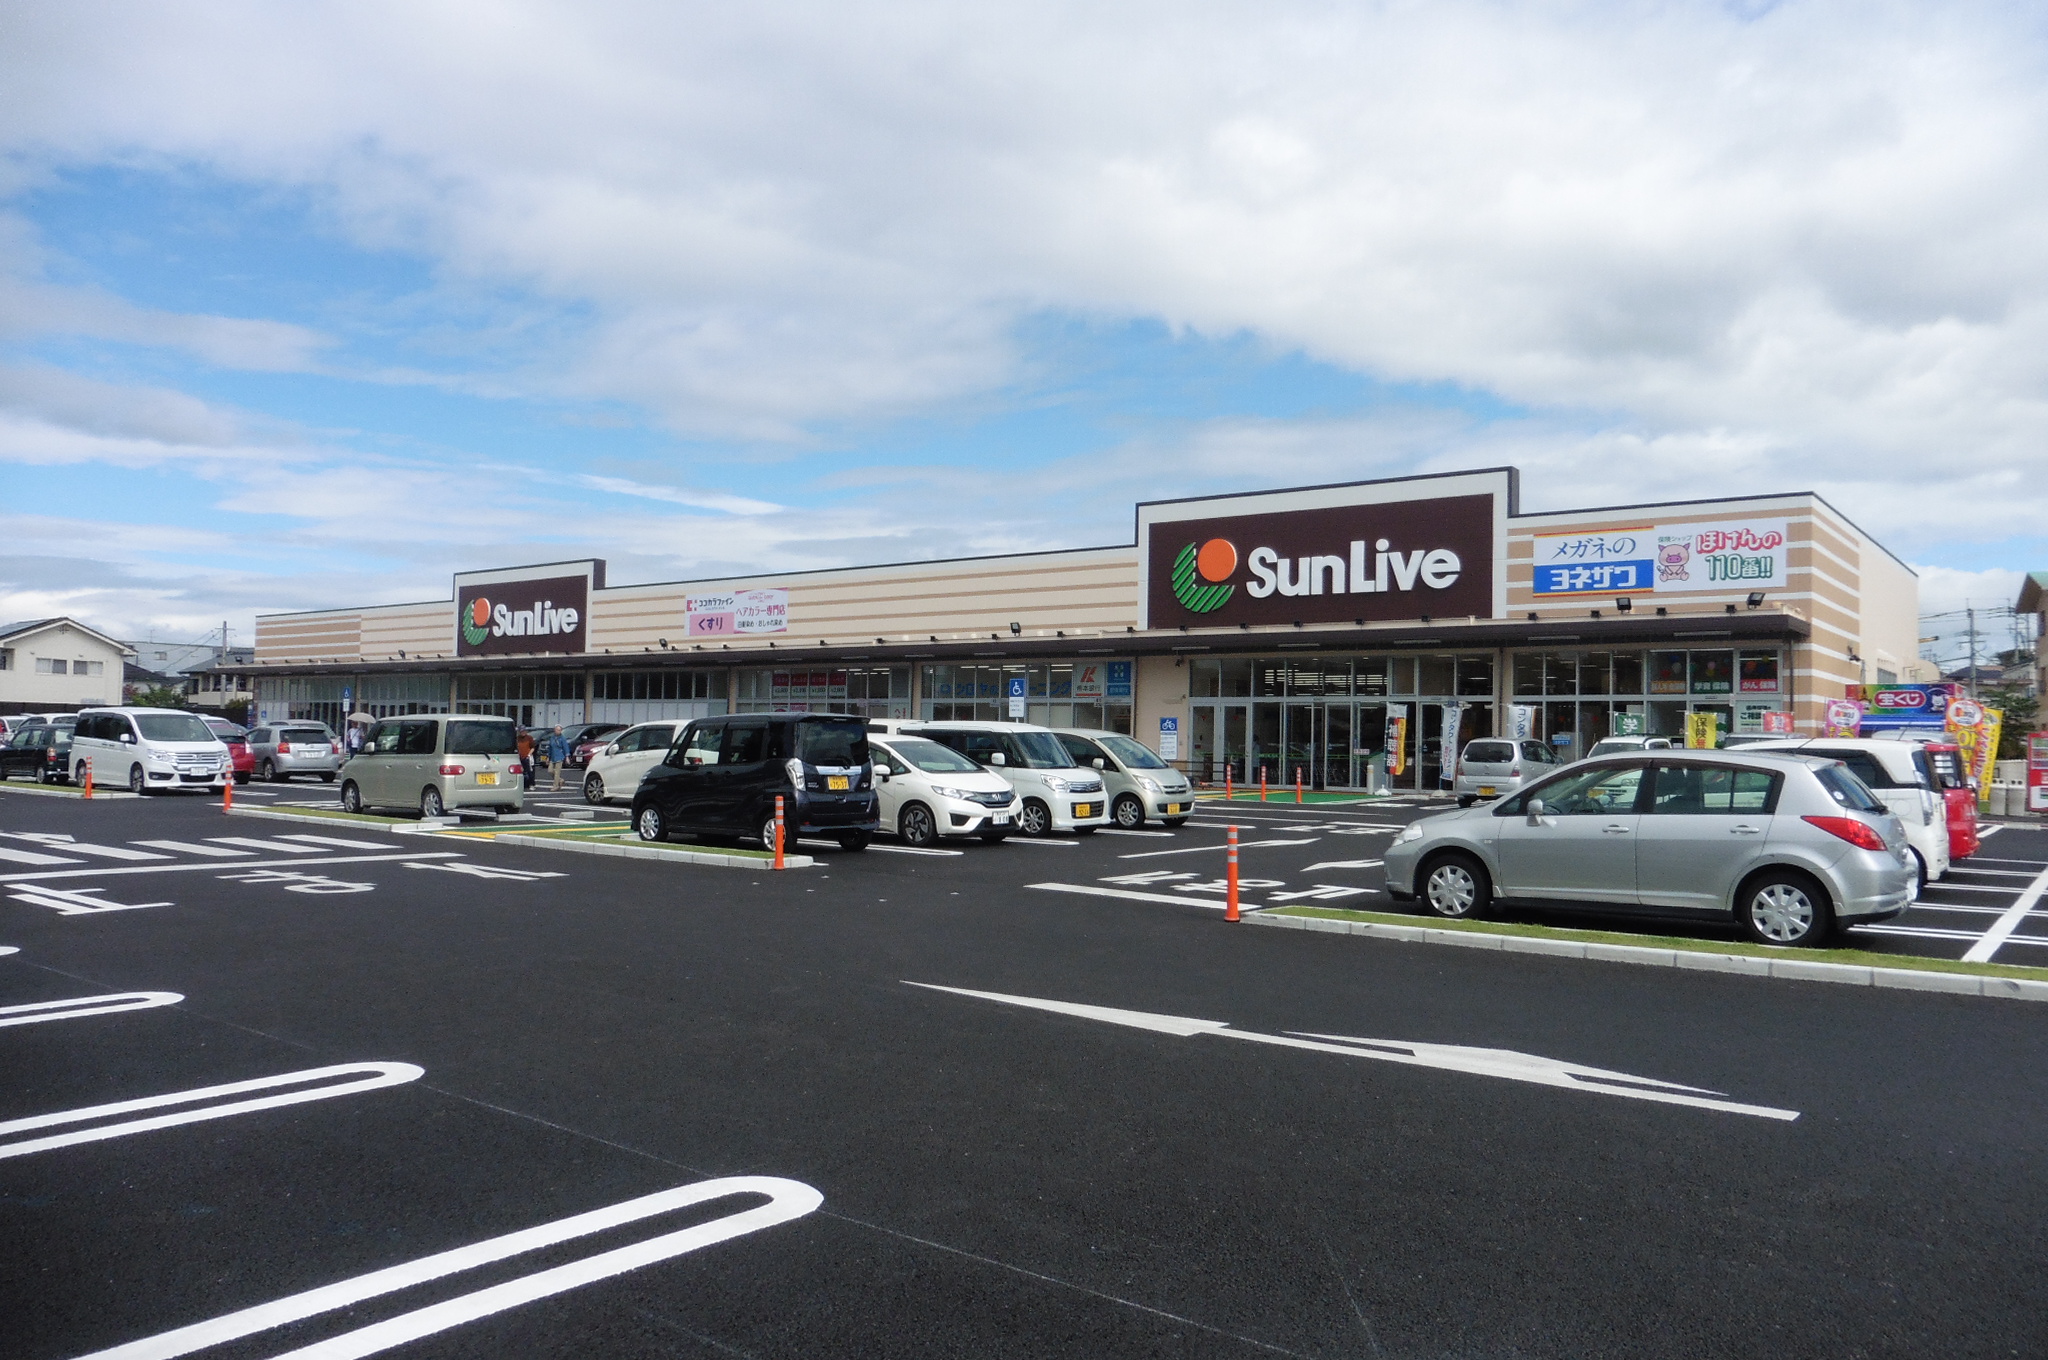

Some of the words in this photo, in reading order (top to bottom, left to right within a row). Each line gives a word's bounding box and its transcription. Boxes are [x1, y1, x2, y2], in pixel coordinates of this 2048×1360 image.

[1551, 537, 1636, 559] メガネの
[1695, 528, 1783, 555] ほけんの
[1245, 538, 1461, 599] SunLive
[1549, 565, 1637, 590] ヨネザワ
[698, 597, 734, 607] ココカラファイン
[736, 604, 786, 617] ヘアカラー専門店
[492, 600, 579, 638] SunLive
[698, 616, 723, 631] くすり
[1878, 692, 1921, 706] 宝くじ
